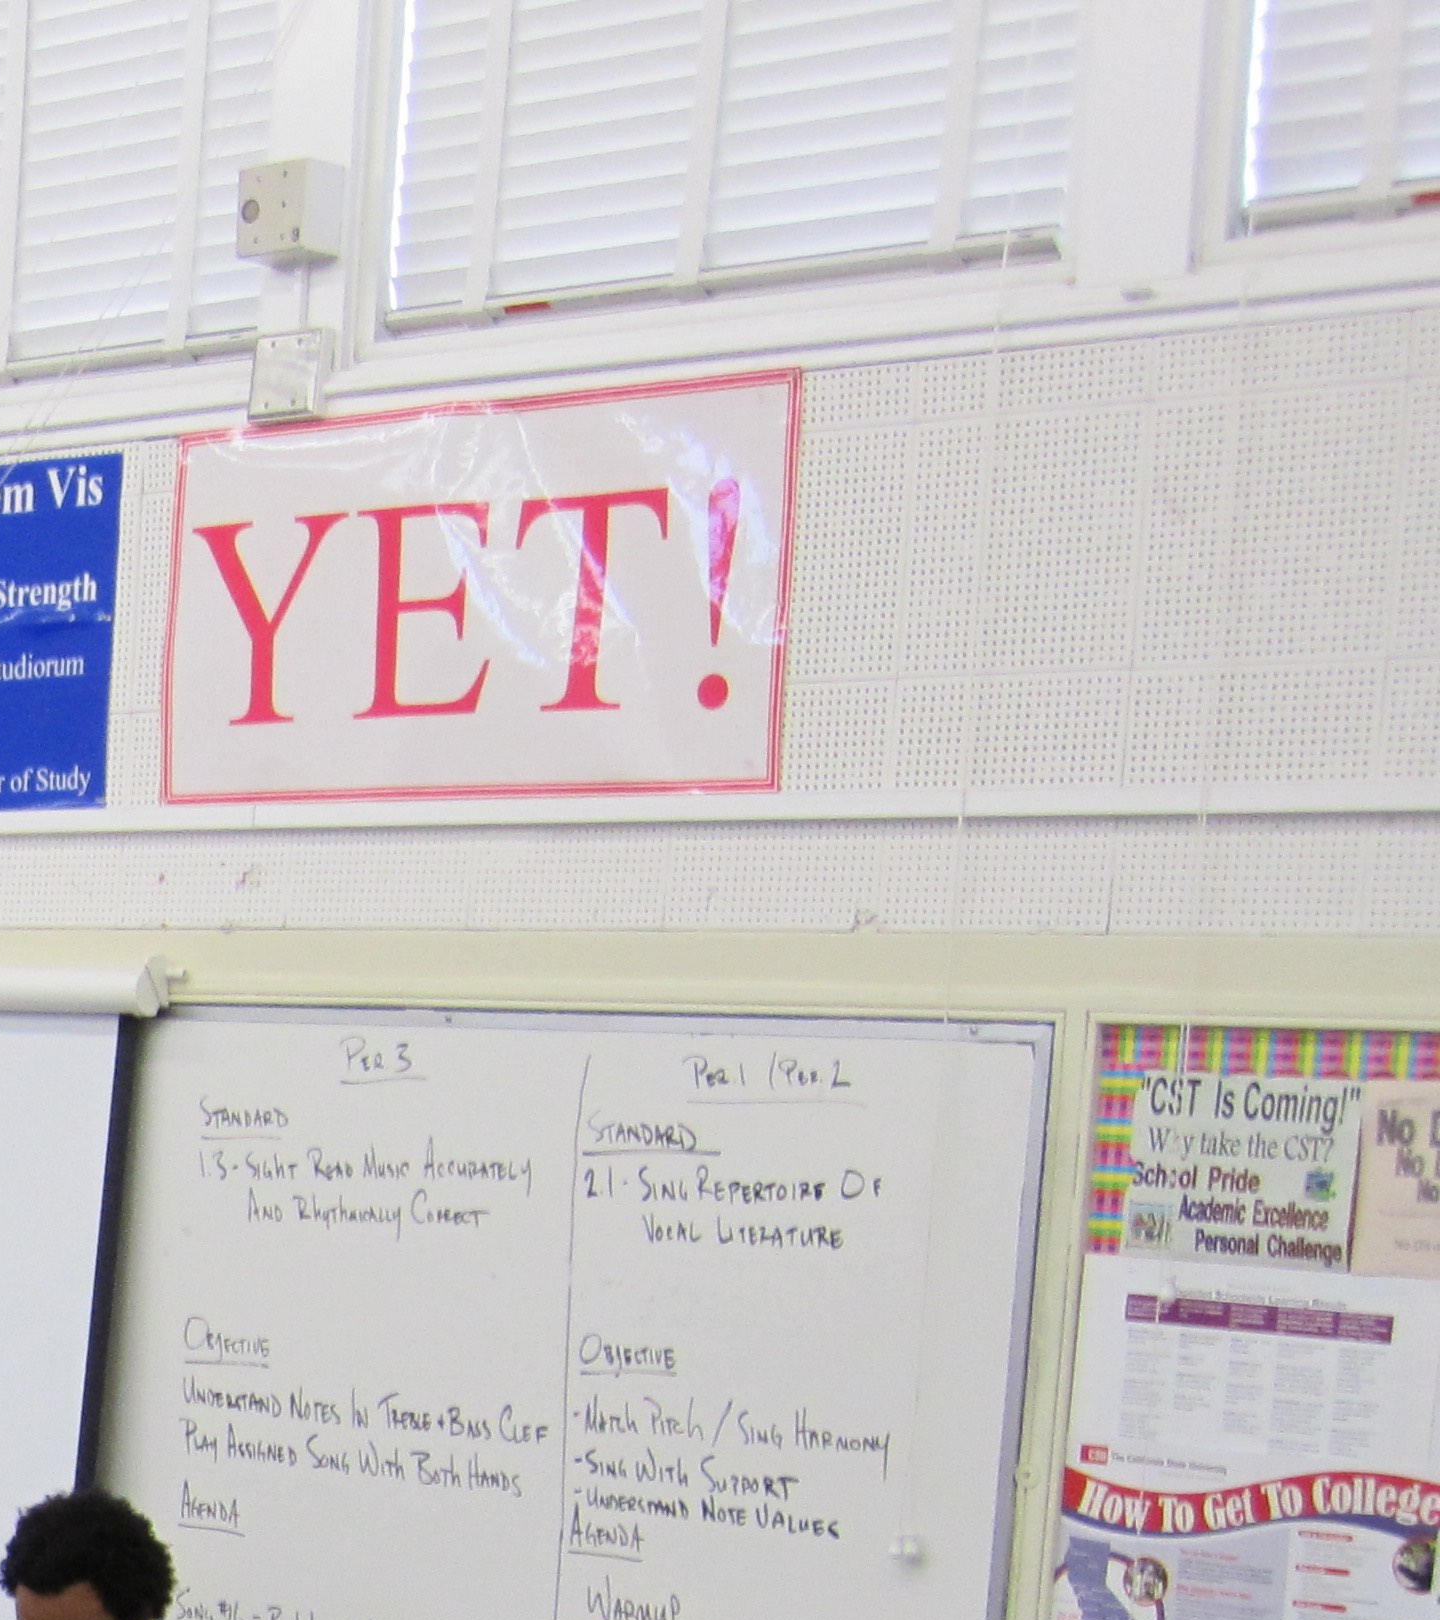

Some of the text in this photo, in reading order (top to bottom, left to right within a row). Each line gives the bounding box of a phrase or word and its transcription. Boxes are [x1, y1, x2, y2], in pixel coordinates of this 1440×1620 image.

[46, 464, 105, 510] Vis
[192, 478, 742, 726] YET!
[10, 769, 32, 793] of
[35, 764, 92, 797] Study
[397, 1043, 412, 1072] 3
[1213, 1079, 1235, 1121] Is
[1242, 1082, 1362, 1135] Coming!"
[1149, 1126, 1335, 1164] Wy take the CST?
[1208, 1165, 1262, 1195] Pride
[1178, 1194, 1329, 1232] Academic Excellence
[1194, 1228, 1343, 1268] Personal Challenge
[1077, 1476, 1440, 1533] How To Get To College
